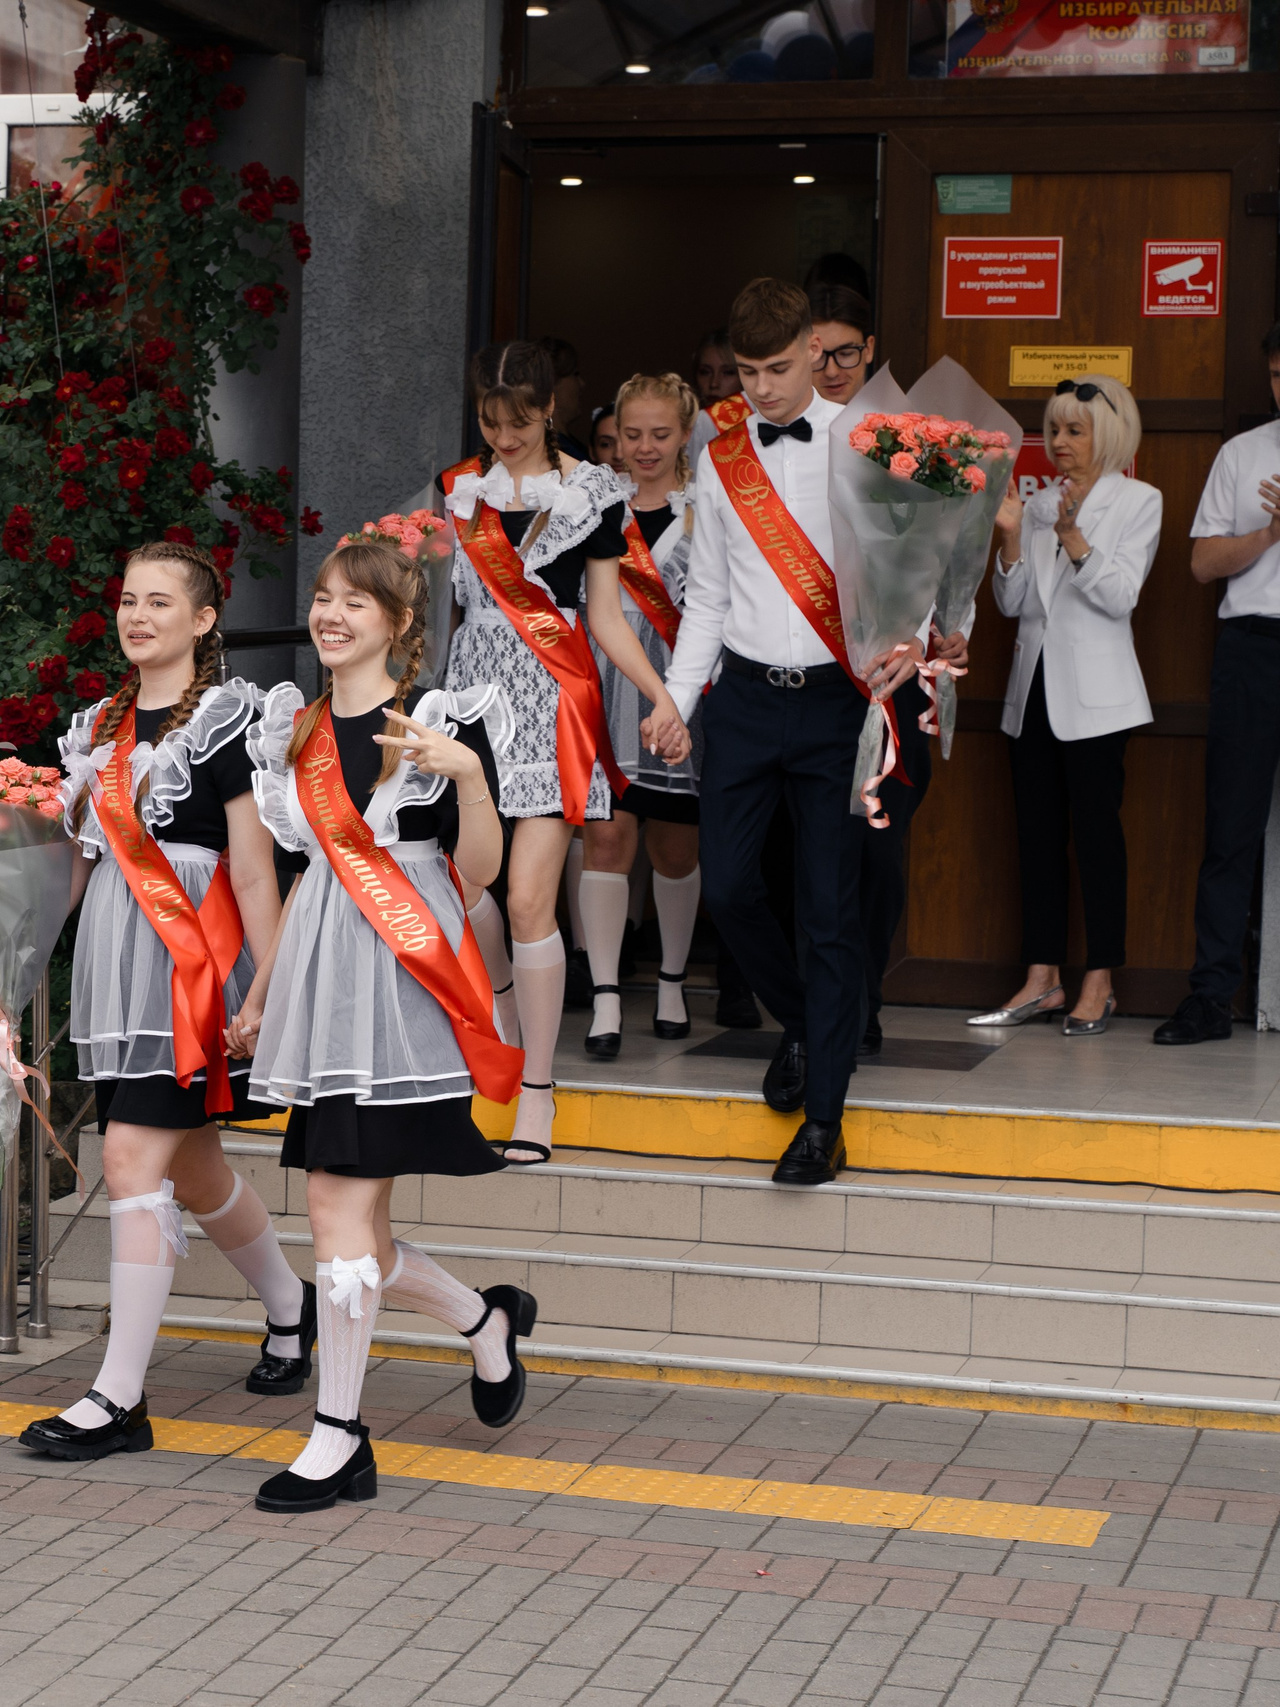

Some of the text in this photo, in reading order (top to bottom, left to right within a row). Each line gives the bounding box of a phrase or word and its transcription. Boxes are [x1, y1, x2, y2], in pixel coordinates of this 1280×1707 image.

[1059, 1, 1238, 17] ИЗБИРАТЕЛЬНАЯ
[1088, 23, 1207, 41] КОМИССИЯ
[957, 53, 1093, 68] ИЗБИРАТЕЛЬНОГО
[1098, 51, 1170, 65] УЧАСТКА
[949, 250, 1057, 262] В учреждении установлен
[1149, 246, 1218, 256] ВНИМАНИЕ!!!
[978, 264, 1027, 276] пропускной
[959, 281, 966, 290] и
[986, 295, 1017, 305] режим
[1157, 295, 1206, 305] ВЕДЕТСЯ
[1022, 351, 1119, 363] Избирательный участок
[1064, 362, 1088, 372] 35-03
[730, 455, 832, 612] Выпускник
[770, 504, 810, 562] Макаренко
[804, 556, 834, 590] Артём
[523, 607, 569, 649] 2026
[332, 781, 370, 843] Винокурова
[303, 728, 440, 952] Выпускница 2026
[141, 874, 191, 922] 2026
